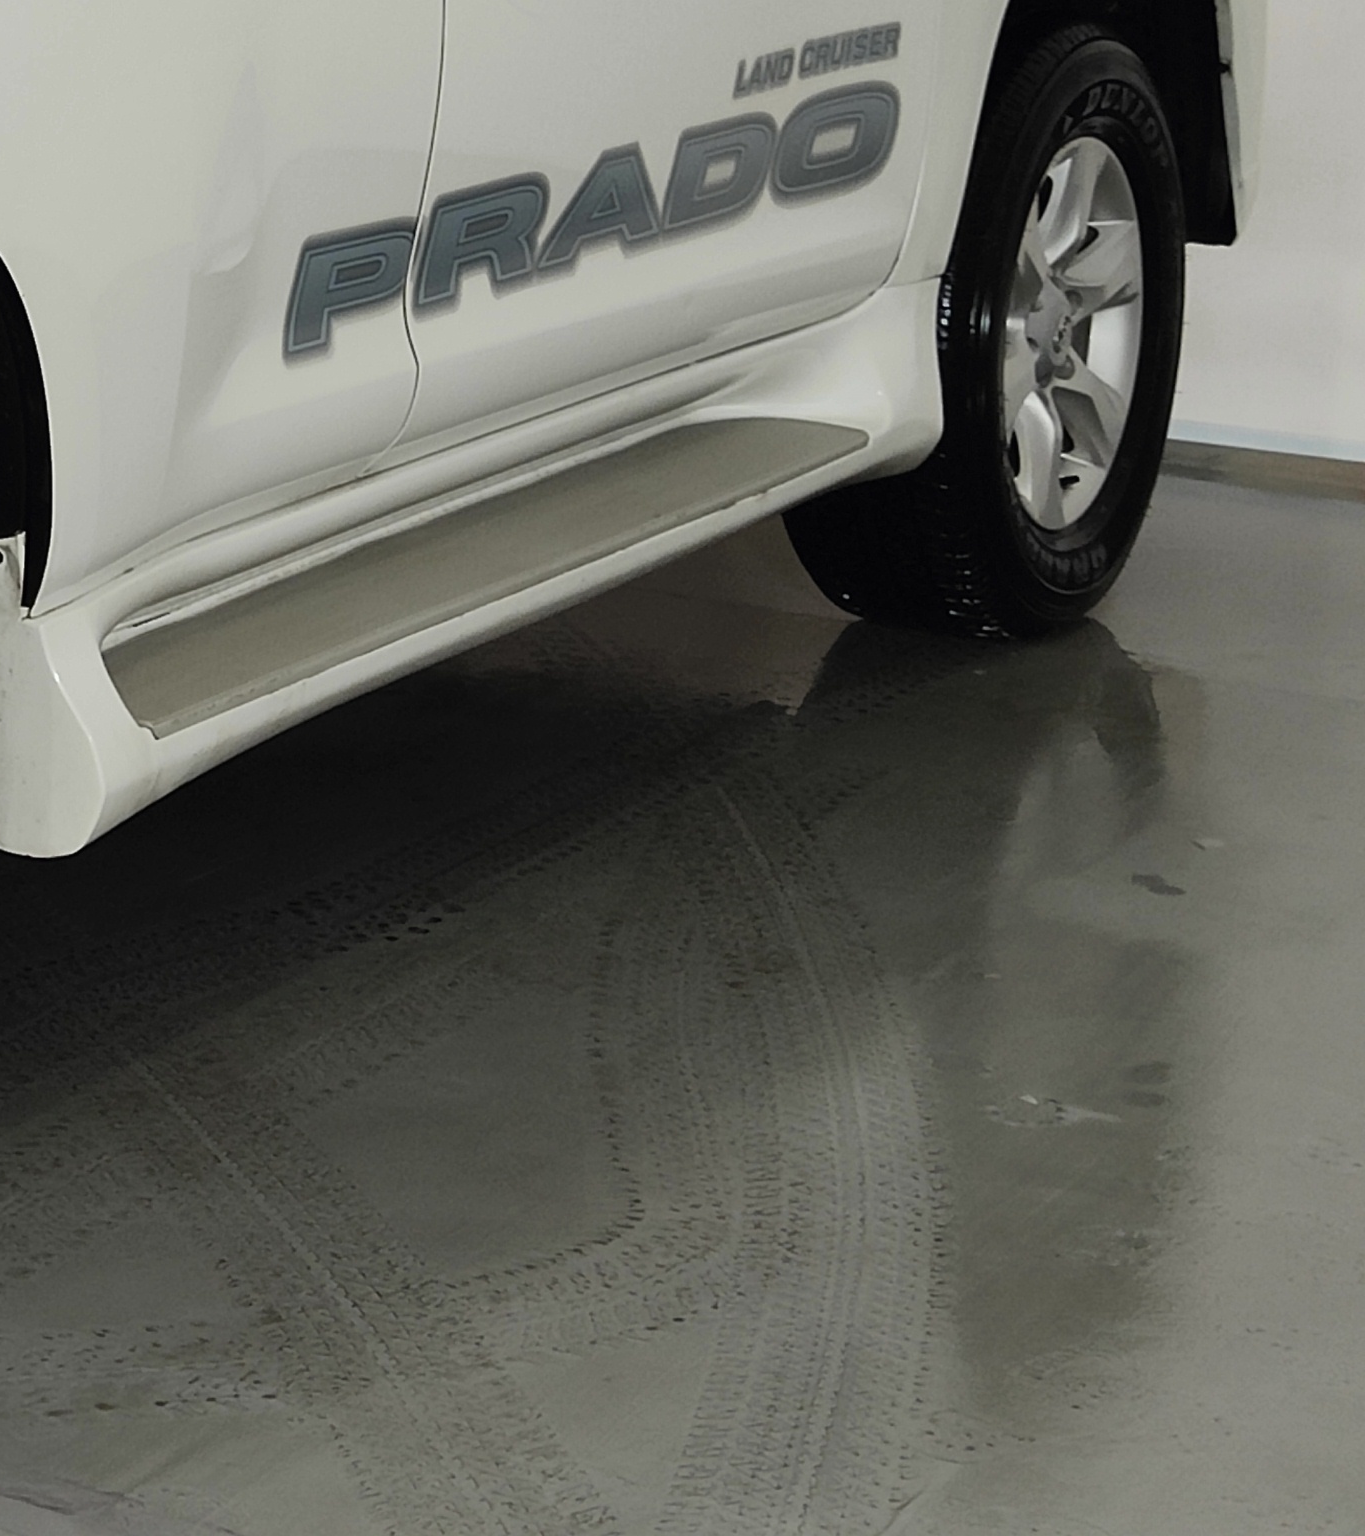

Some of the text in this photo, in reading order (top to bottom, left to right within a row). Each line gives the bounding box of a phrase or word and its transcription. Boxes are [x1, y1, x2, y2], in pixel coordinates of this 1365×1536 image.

[733, 21, 901, 100] LAND CRUISER
[1082, 83, 1169, 167] DUNLOP
[282, 80, 901, 368] PRADO
